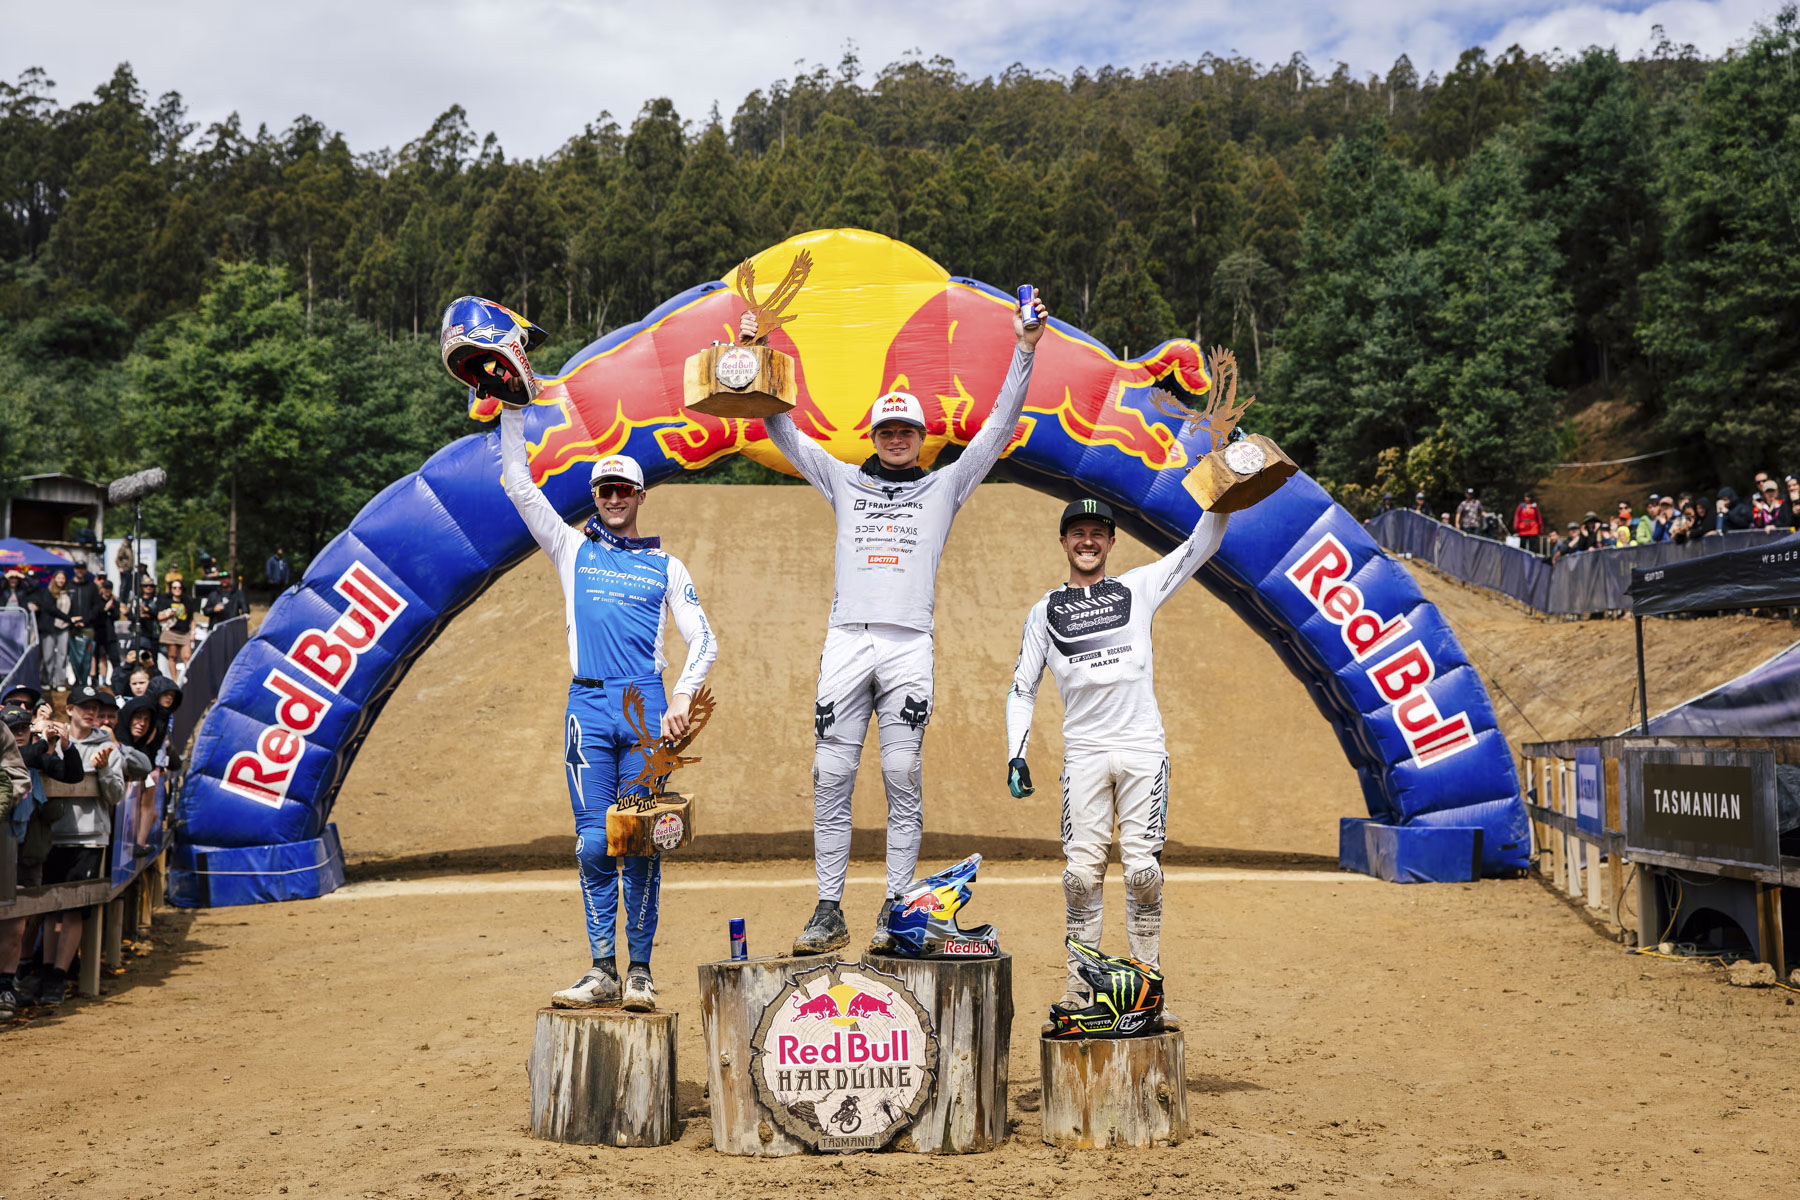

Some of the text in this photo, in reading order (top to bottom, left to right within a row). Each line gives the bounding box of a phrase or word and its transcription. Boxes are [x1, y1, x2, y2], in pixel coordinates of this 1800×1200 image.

[509, 340, 528, 365] Red
[721, 360, 754, 370] Red Bull
[895, 405, 908, 413] Bull
[1243, 447, 1257, 457] Bull
[601, 466, 612, 474] Red
[592, 522, 618, 544] OAKLEY
[899, 526, 918, 536] AXIS
[869, 556, 897, 564] LOCTITE
[577, 566, 666, 590] MONDRAKER
[588, 576, 651, 591] FACTORY RACING
[1053, 592, 1125, 615] CANYON
[1070, 606, 1114, 621] SRAM
[1082, 653, 1099, 661] SWISS
[1106, 644, 1133, 656] ROCKSHOX
[1292, 538, 1473, 763] Red Bull
[1090, 657, 1120, 668] MAXXIS
[225, 565, 402, 804] Red Bull
[638, 794, 658, 813] 2nd
[1653, 788, 1741, 820] TASMANIAN
[655, 824, 681, 836] Red Bull
[637, 861, 654, 931] MONDRAKER
[945, 940, 994, 954] Red Bull
[1084, 1019, 1113, 1027] MONSTER
[778, 1029, 909, 1065] Red Bull
[777, 1067, 912, 1092] HARDLINE
[821, 1136, 877, 1148] TASMANIA
